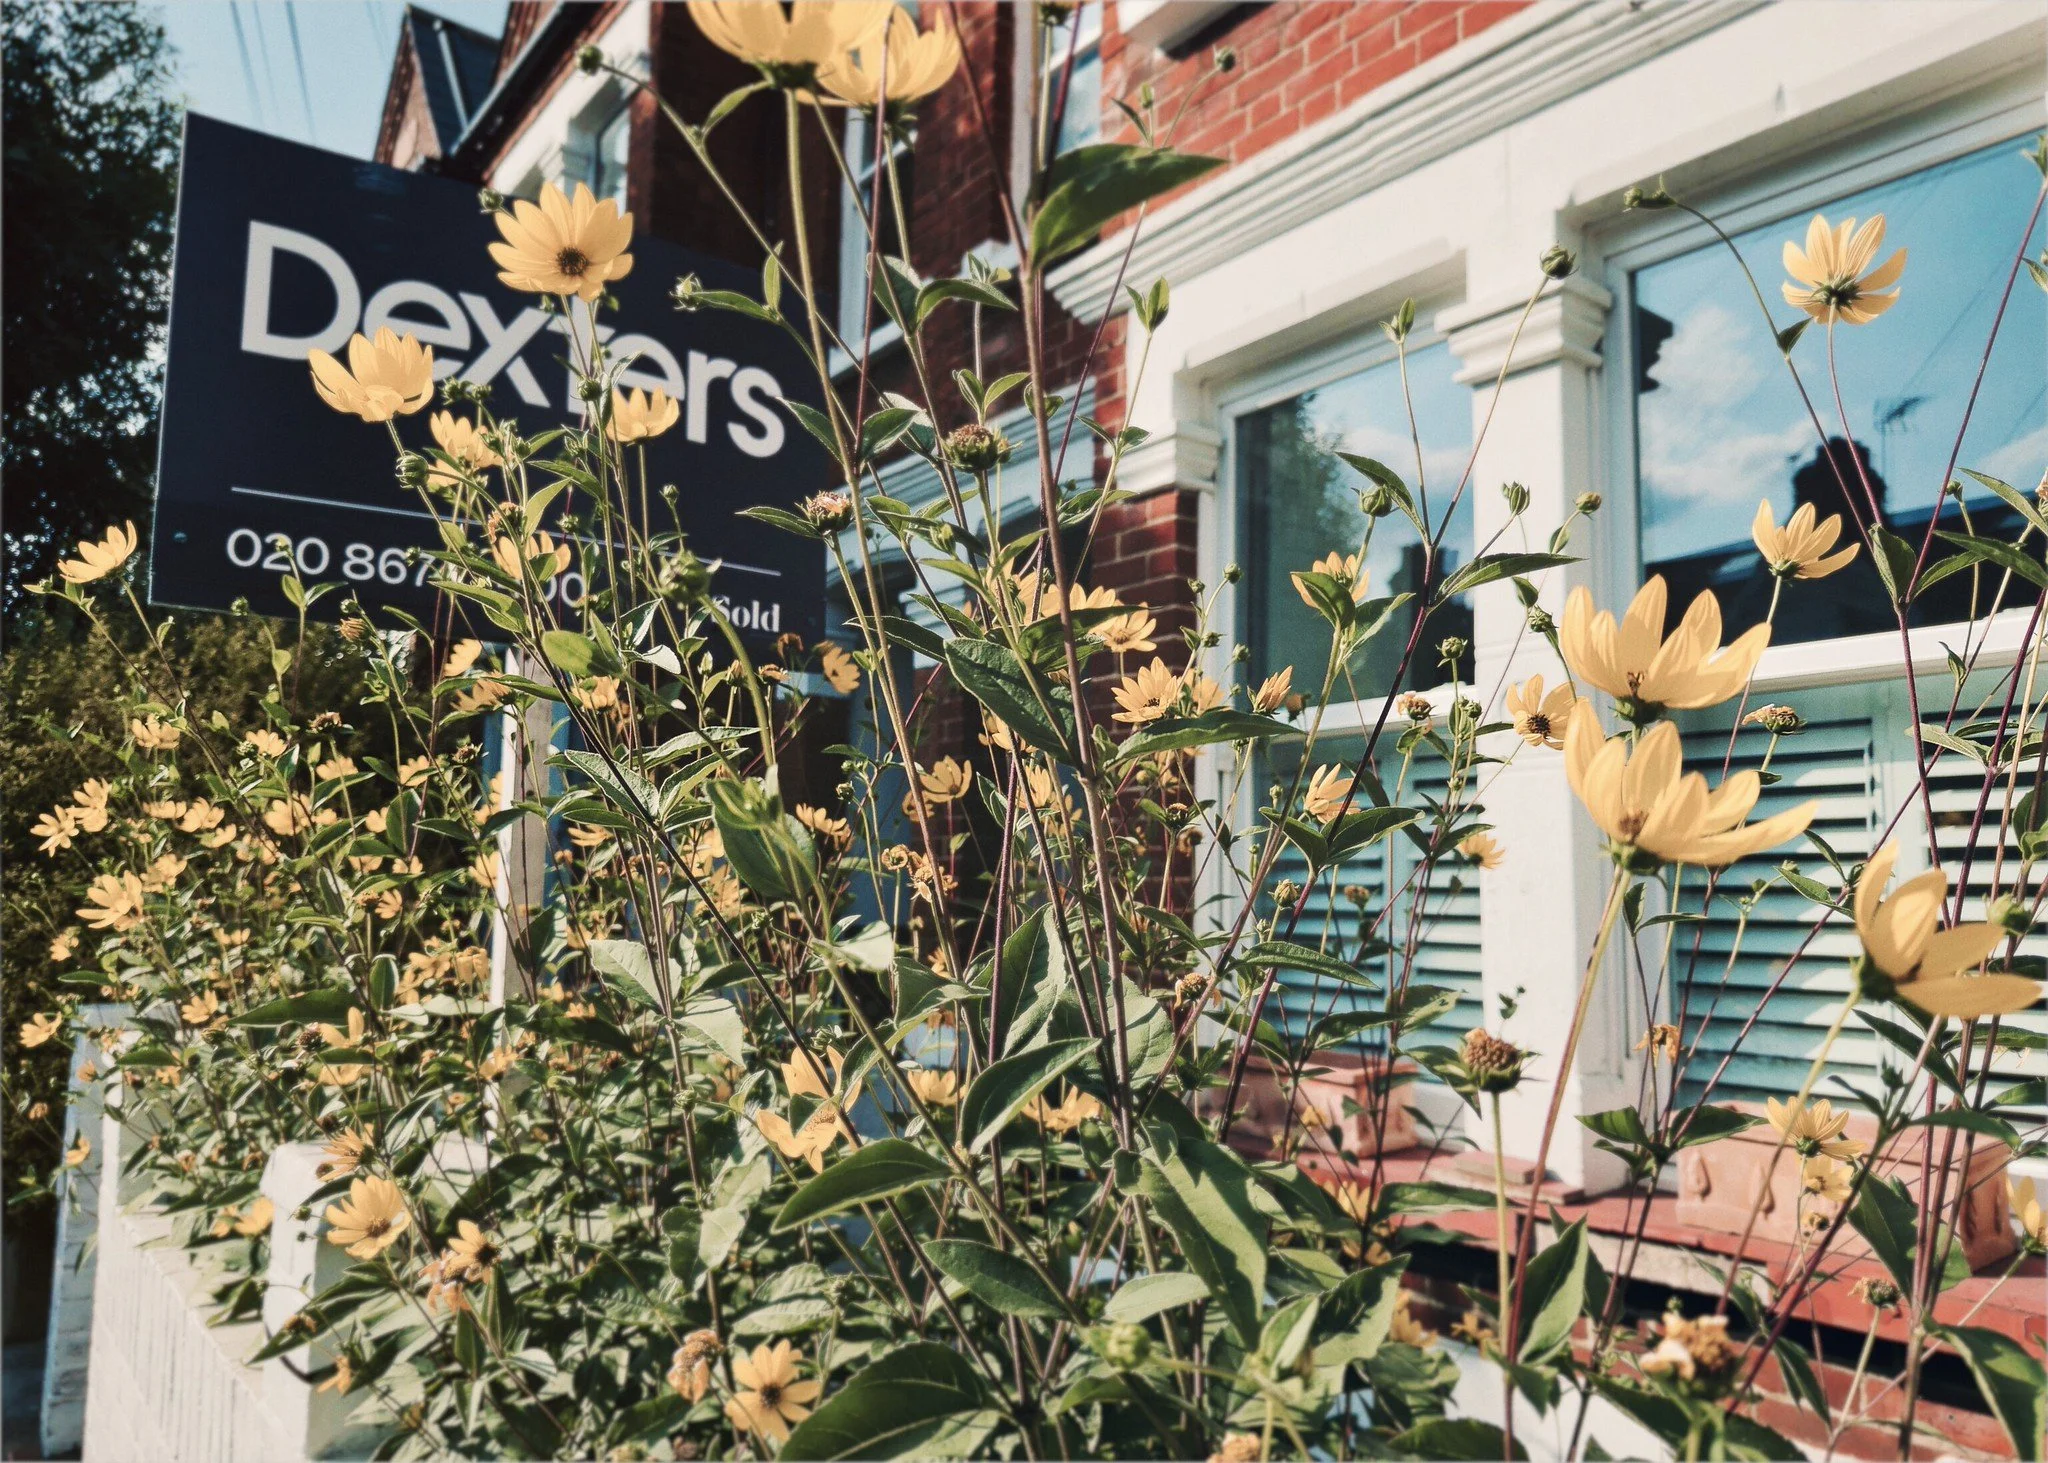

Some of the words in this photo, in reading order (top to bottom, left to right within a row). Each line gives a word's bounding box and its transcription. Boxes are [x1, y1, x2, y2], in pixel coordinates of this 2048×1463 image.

[241, 219, 785, 459] Dexters
[226, 528, 330, 576] 020
[710, 593, 781, 633] Sold
